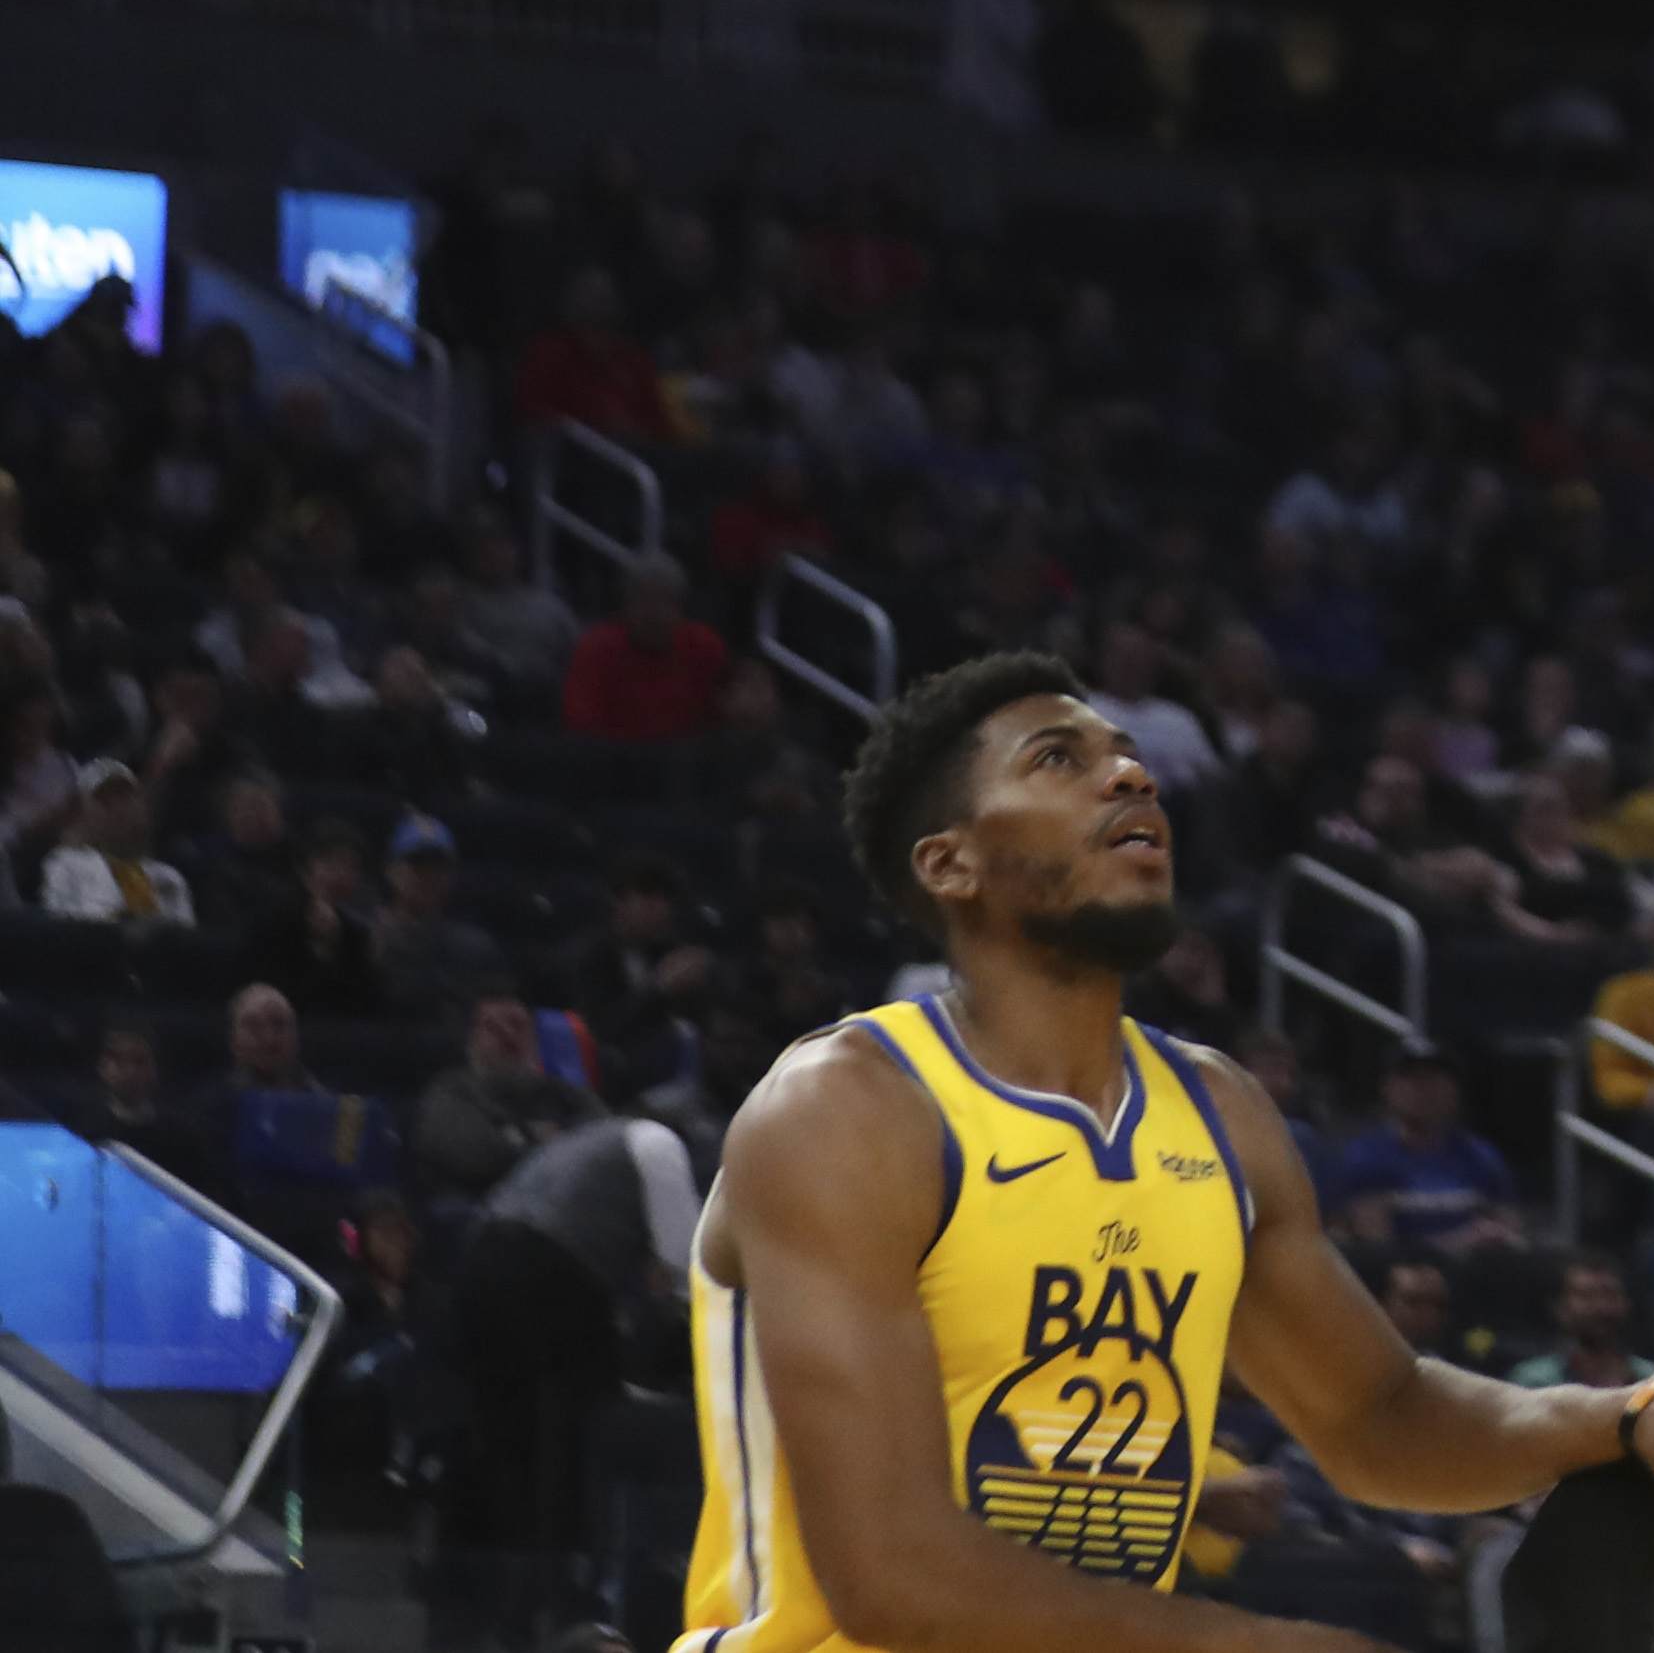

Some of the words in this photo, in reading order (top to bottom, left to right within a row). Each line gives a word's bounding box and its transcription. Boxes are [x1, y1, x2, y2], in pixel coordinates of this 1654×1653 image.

[1092, 1220, 1141, 1263] The
[1023, 1265, 1200, 1363] BAY
[1050, 1376, 1150, 1477] 22
